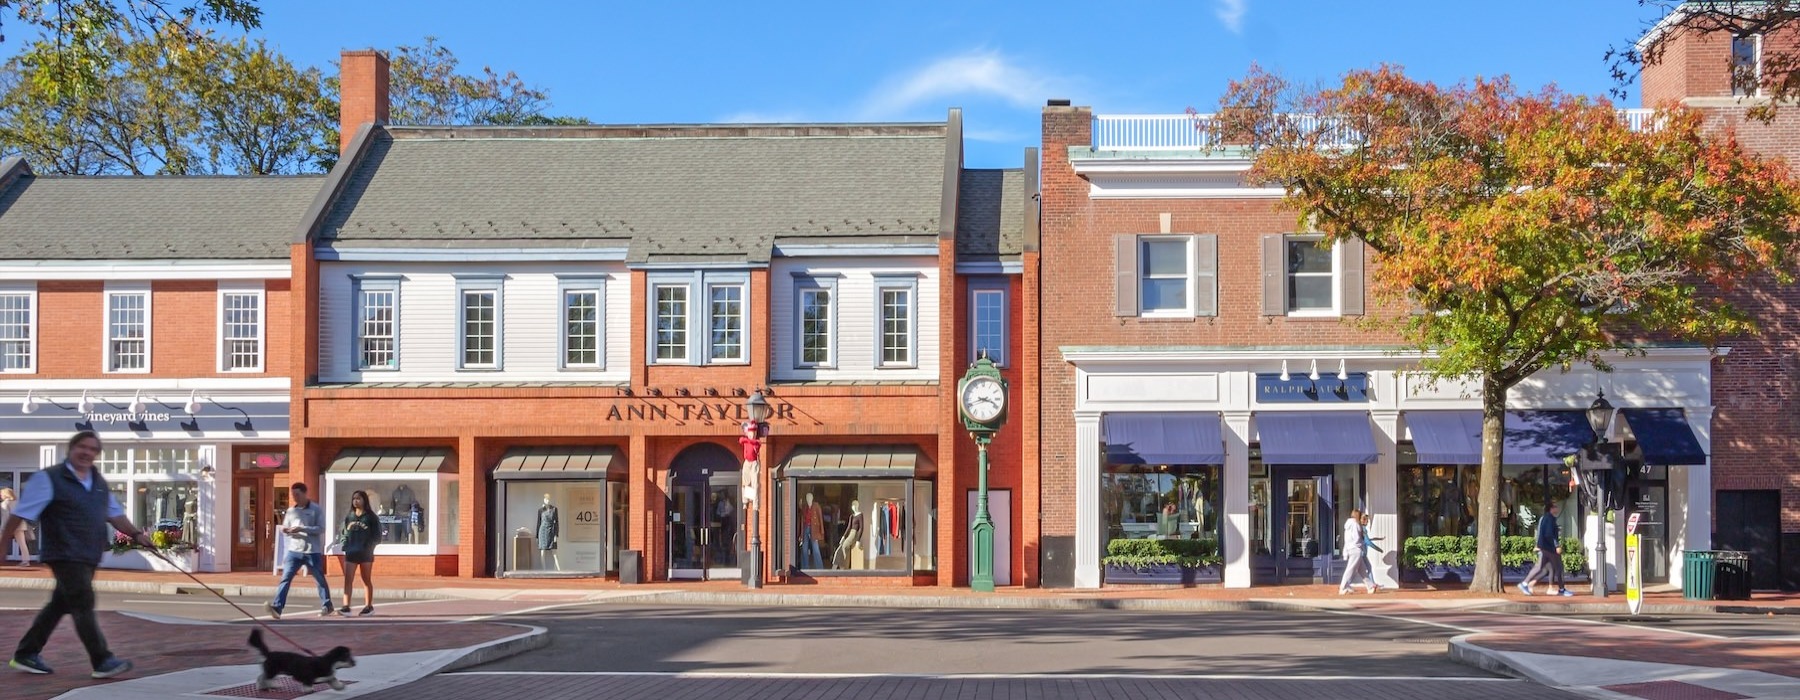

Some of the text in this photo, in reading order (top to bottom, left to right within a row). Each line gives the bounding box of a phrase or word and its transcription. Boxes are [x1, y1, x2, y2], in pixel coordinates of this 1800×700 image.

[1264, 385, 1358, 394] RALPH LAUREN
[138, 410, 170, 422] vines
[606, 404, 667, 421] ANN
[1640, 465, 1652, 474] 47
